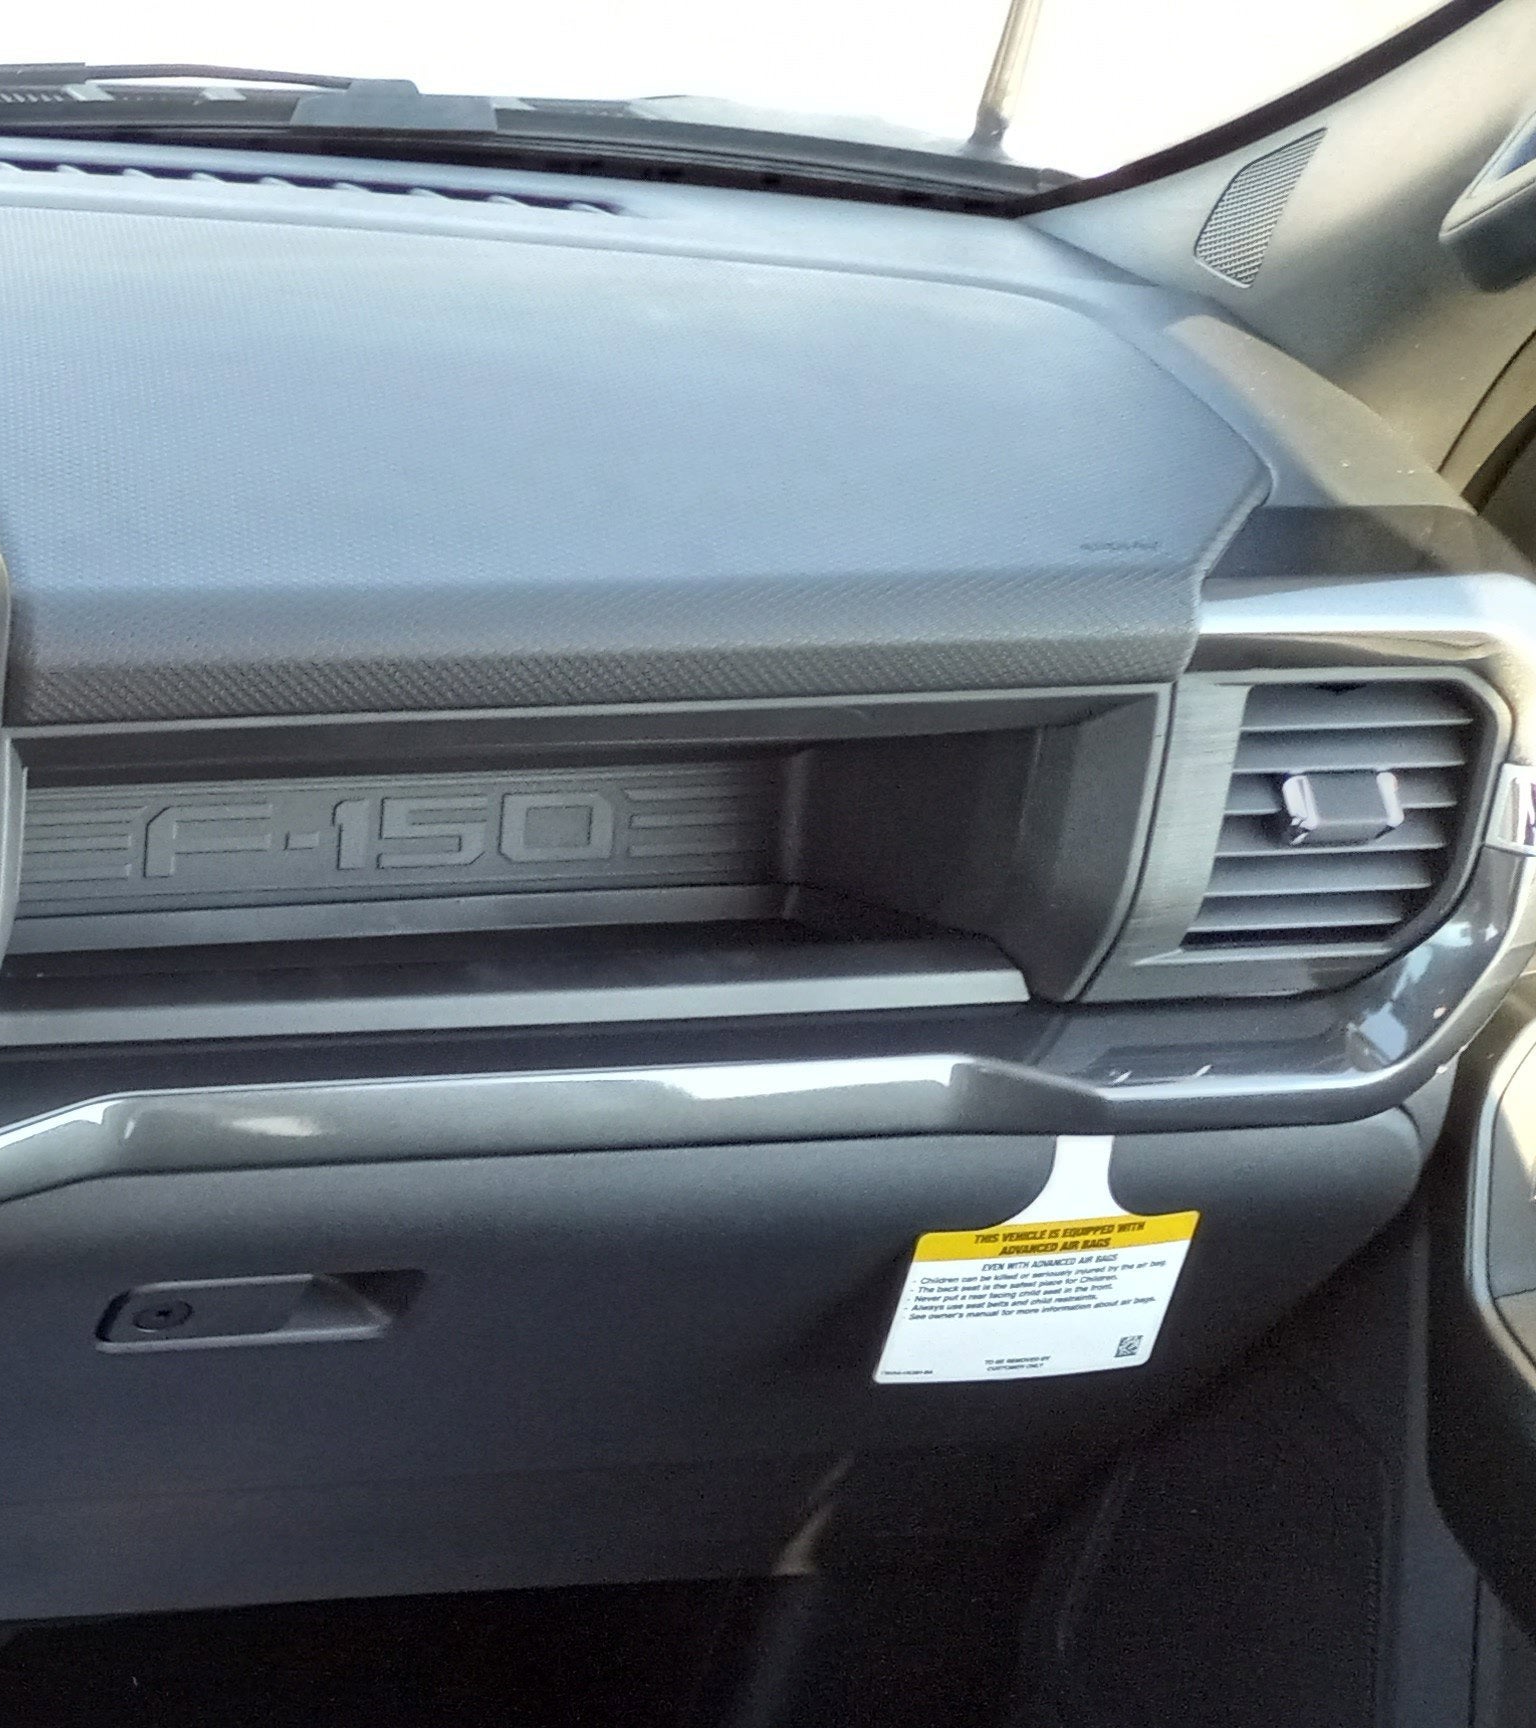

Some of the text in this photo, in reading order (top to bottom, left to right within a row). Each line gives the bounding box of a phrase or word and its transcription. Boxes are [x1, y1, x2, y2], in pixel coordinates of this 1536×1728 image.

[142, 793, 615, 877] F-150
[974, 1234, 999, 1244] THIS
[1002, 1230, 1047, 1242] VEHICLE
[1062, 1224, 1115, 1238] EQUIPPED
[1117, 1221, 1146, 1232] WITH
[998, 1243, 1059, 1256] ADVANCED
[1081, 1238, 1112, 1249] BAGS
[982, 1263, 1005, 1272] EVEN
[1031, 1258, 1077, 1268] ADVANCED
